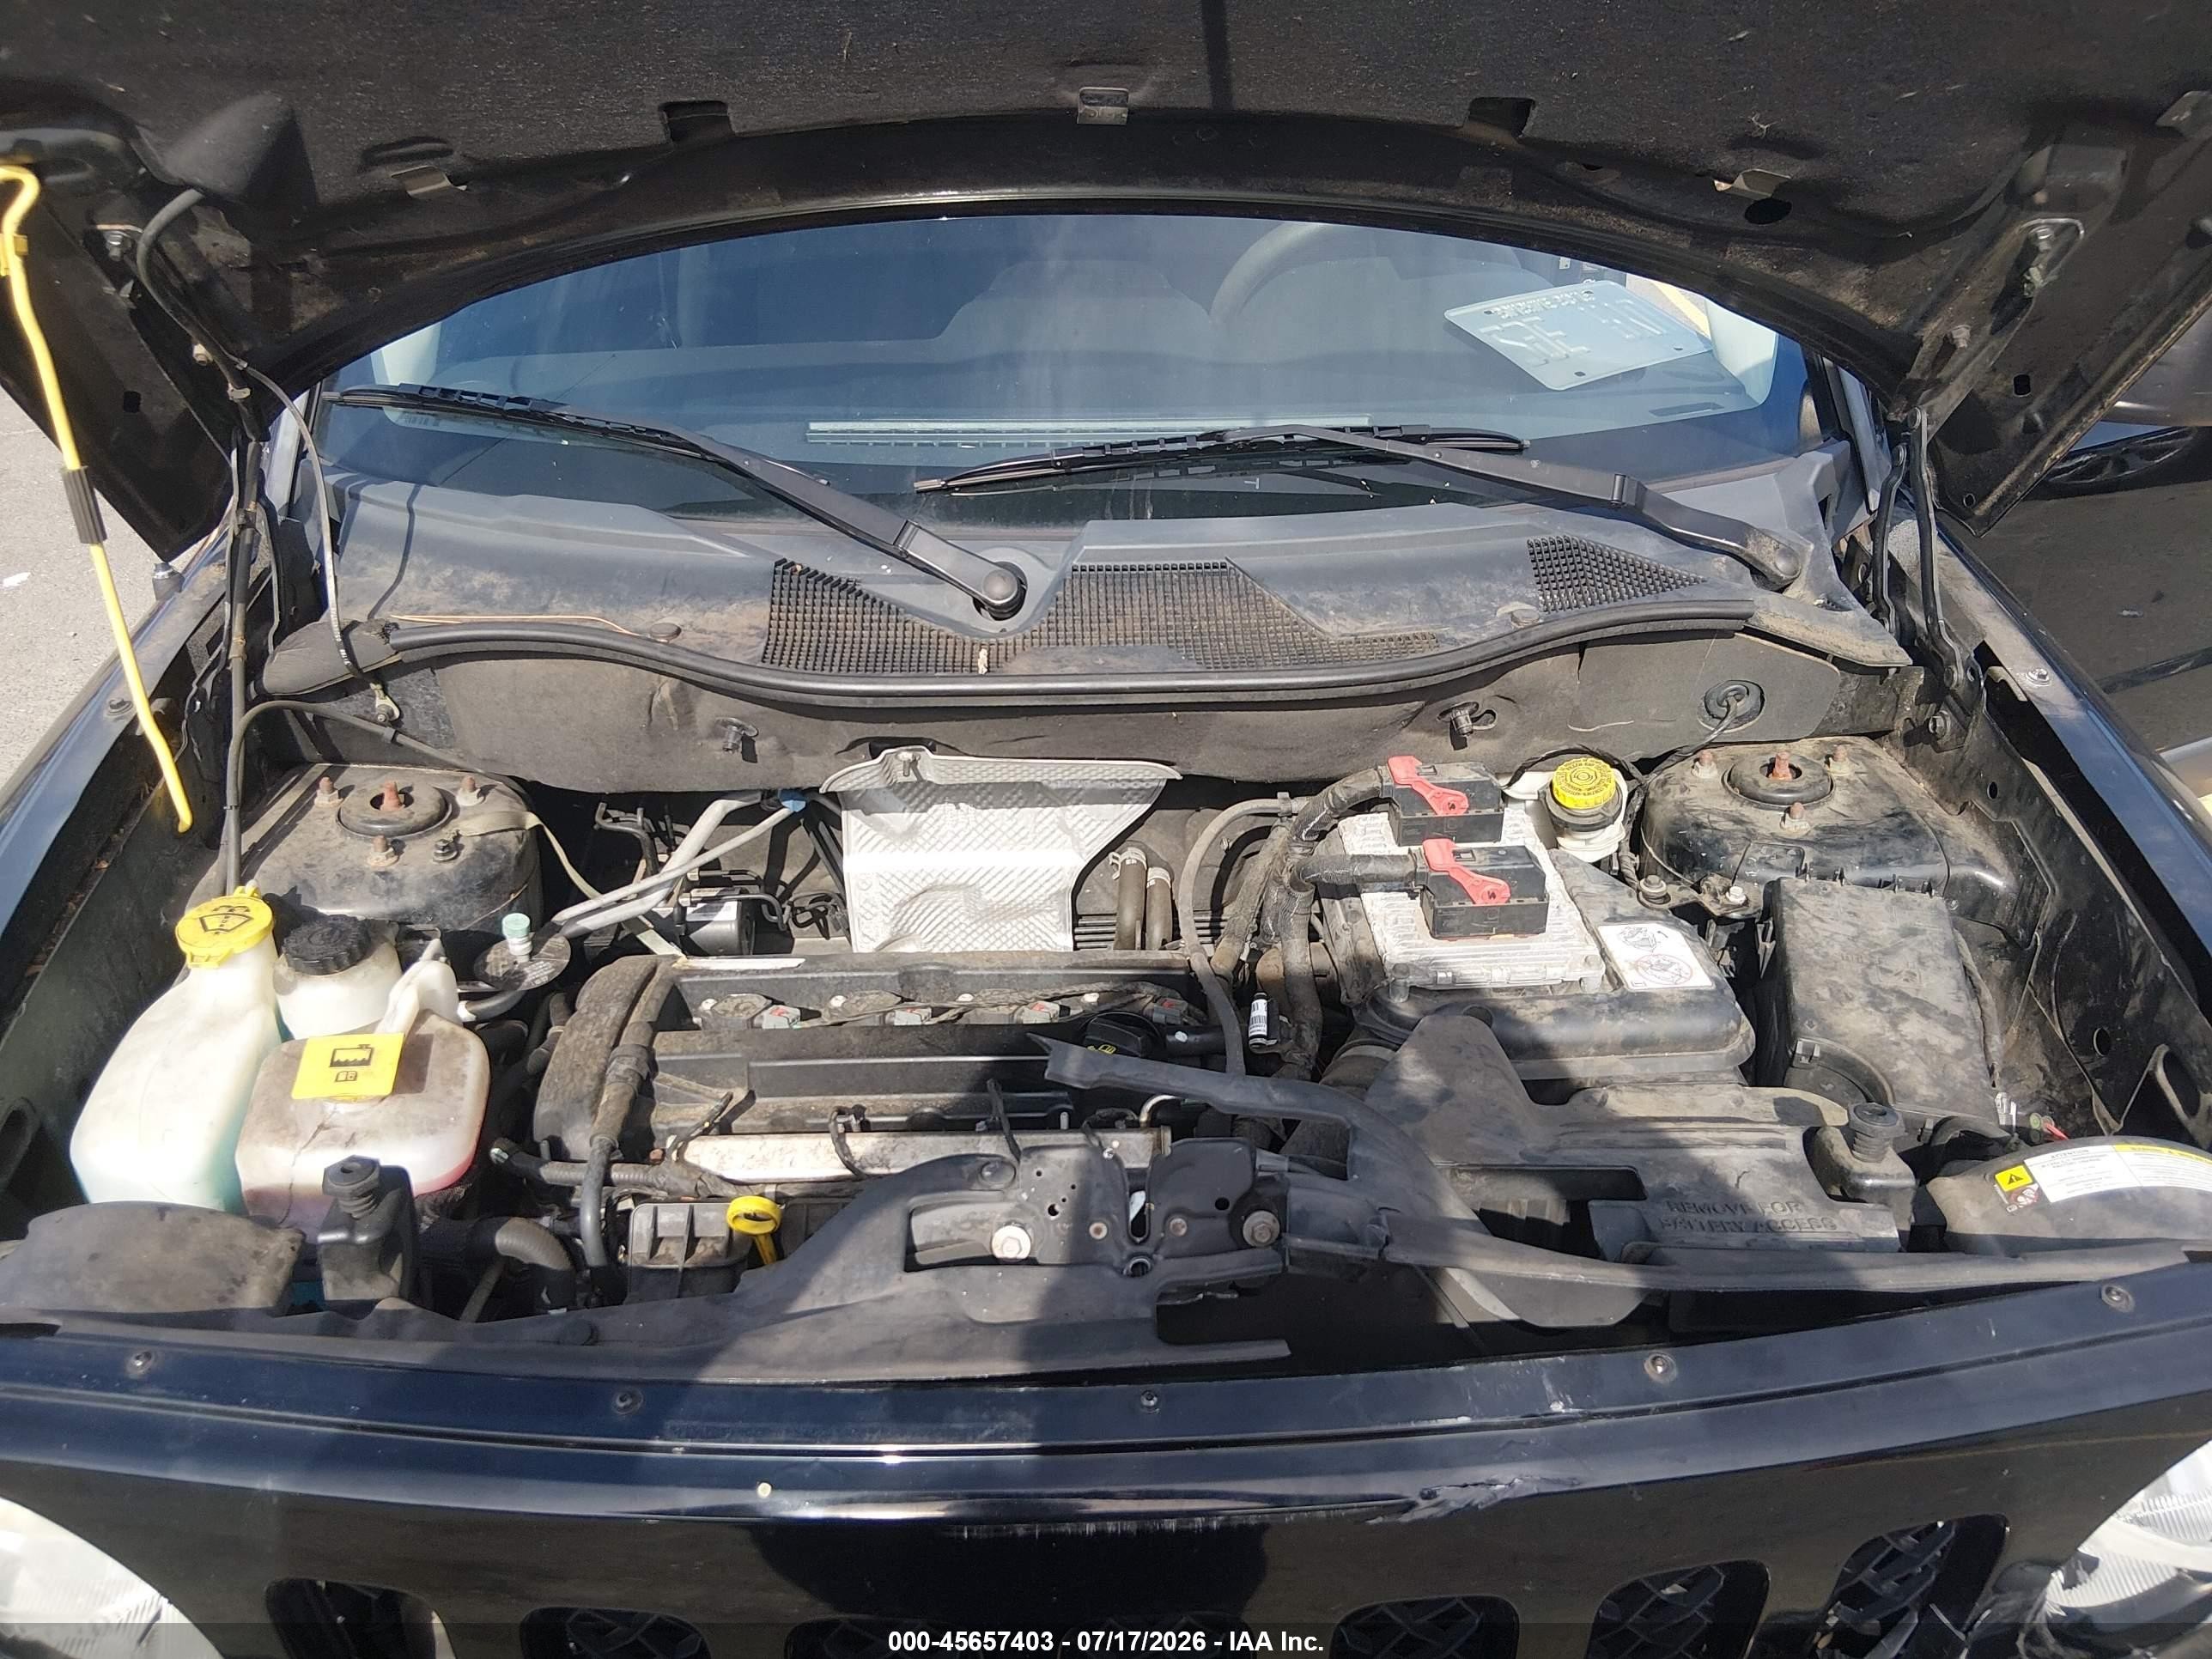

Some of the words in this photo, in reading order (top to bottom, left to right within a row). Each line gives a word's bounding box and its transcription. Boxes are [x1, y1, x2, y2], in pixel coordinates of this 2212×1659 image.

[1666, 1200, 1752, 1216] REMOVE
[1759, 1200, 1802, 1216] FOR
[1659, 1217, 1747, 1233] BATTERY
[1753, 1216, 1838, 1233] ACCESS
